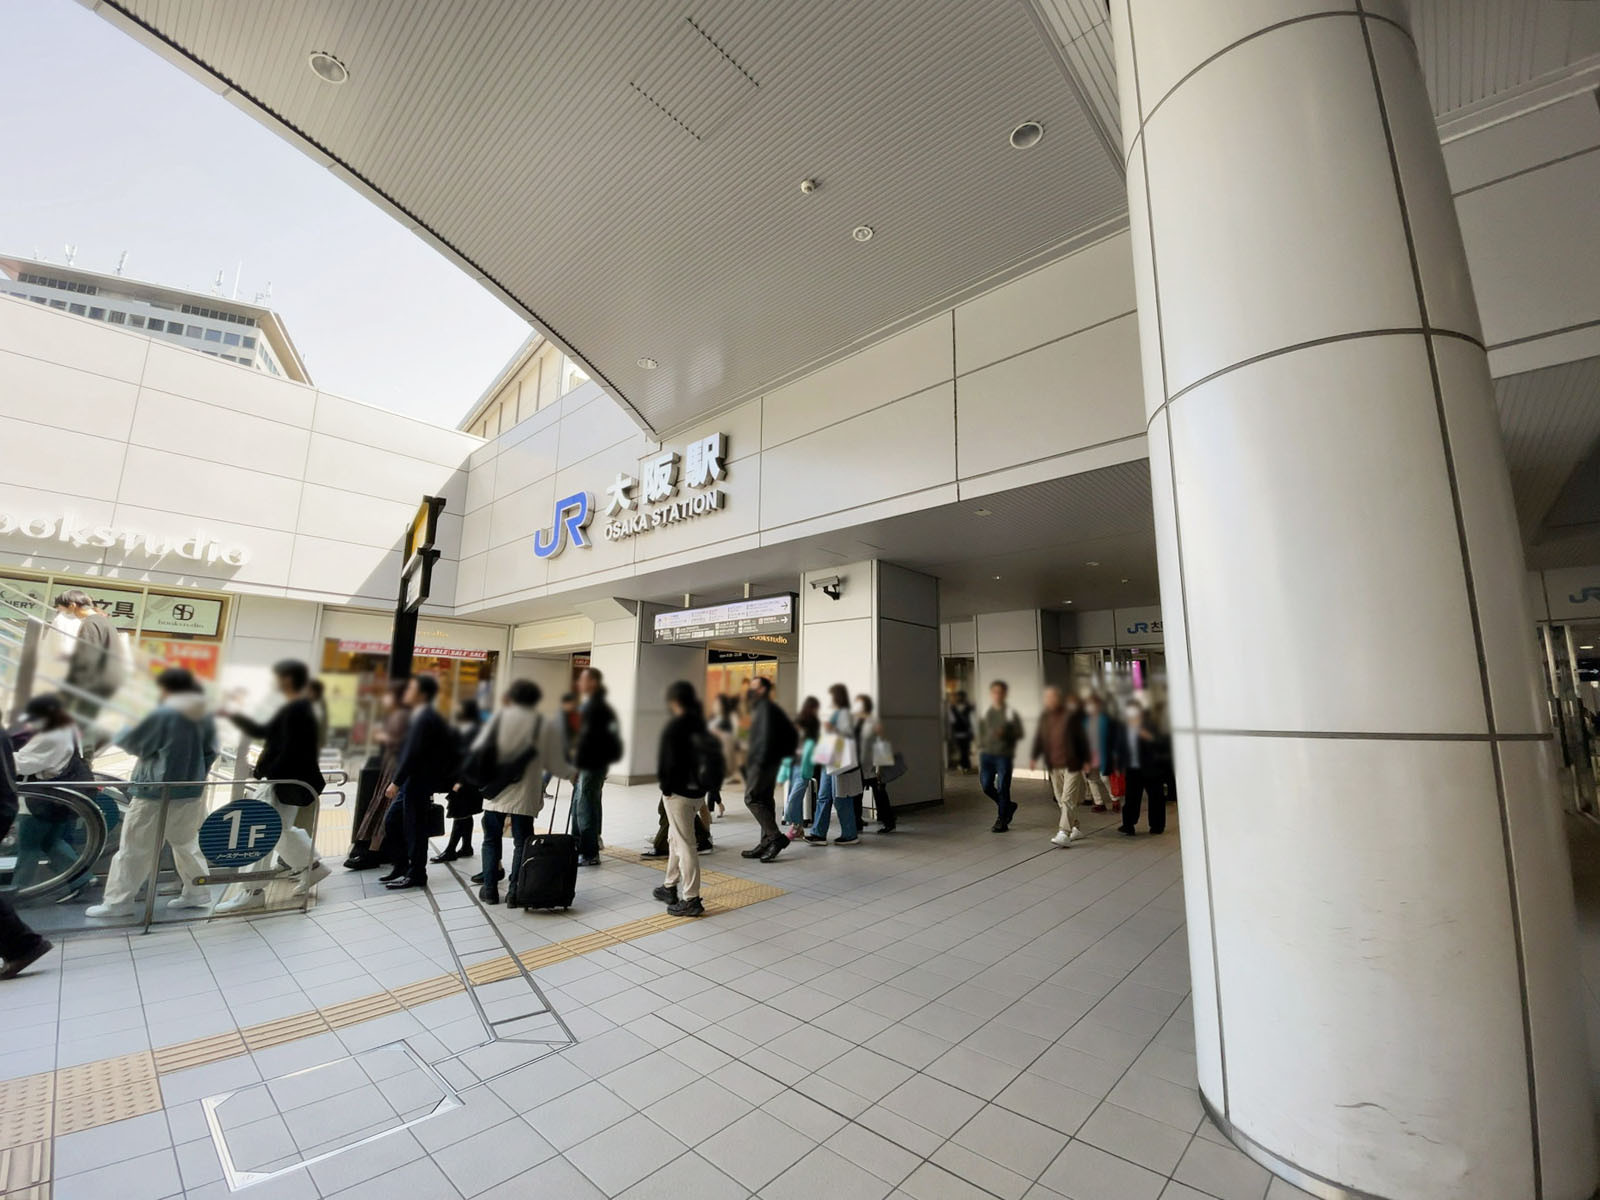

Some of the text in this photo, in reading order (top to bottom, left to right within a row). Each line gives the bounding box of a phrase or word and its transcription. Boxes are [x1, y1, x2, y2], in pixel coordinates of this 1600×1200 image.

[606, 432, 728, 517] 大阪駅
[533, 490, 592, 559] JR
[604, 489, 723, 541] OSAKA STATION
[1127, 622, 1148, 634] JR
[223, 809, 266, 849] 1F
